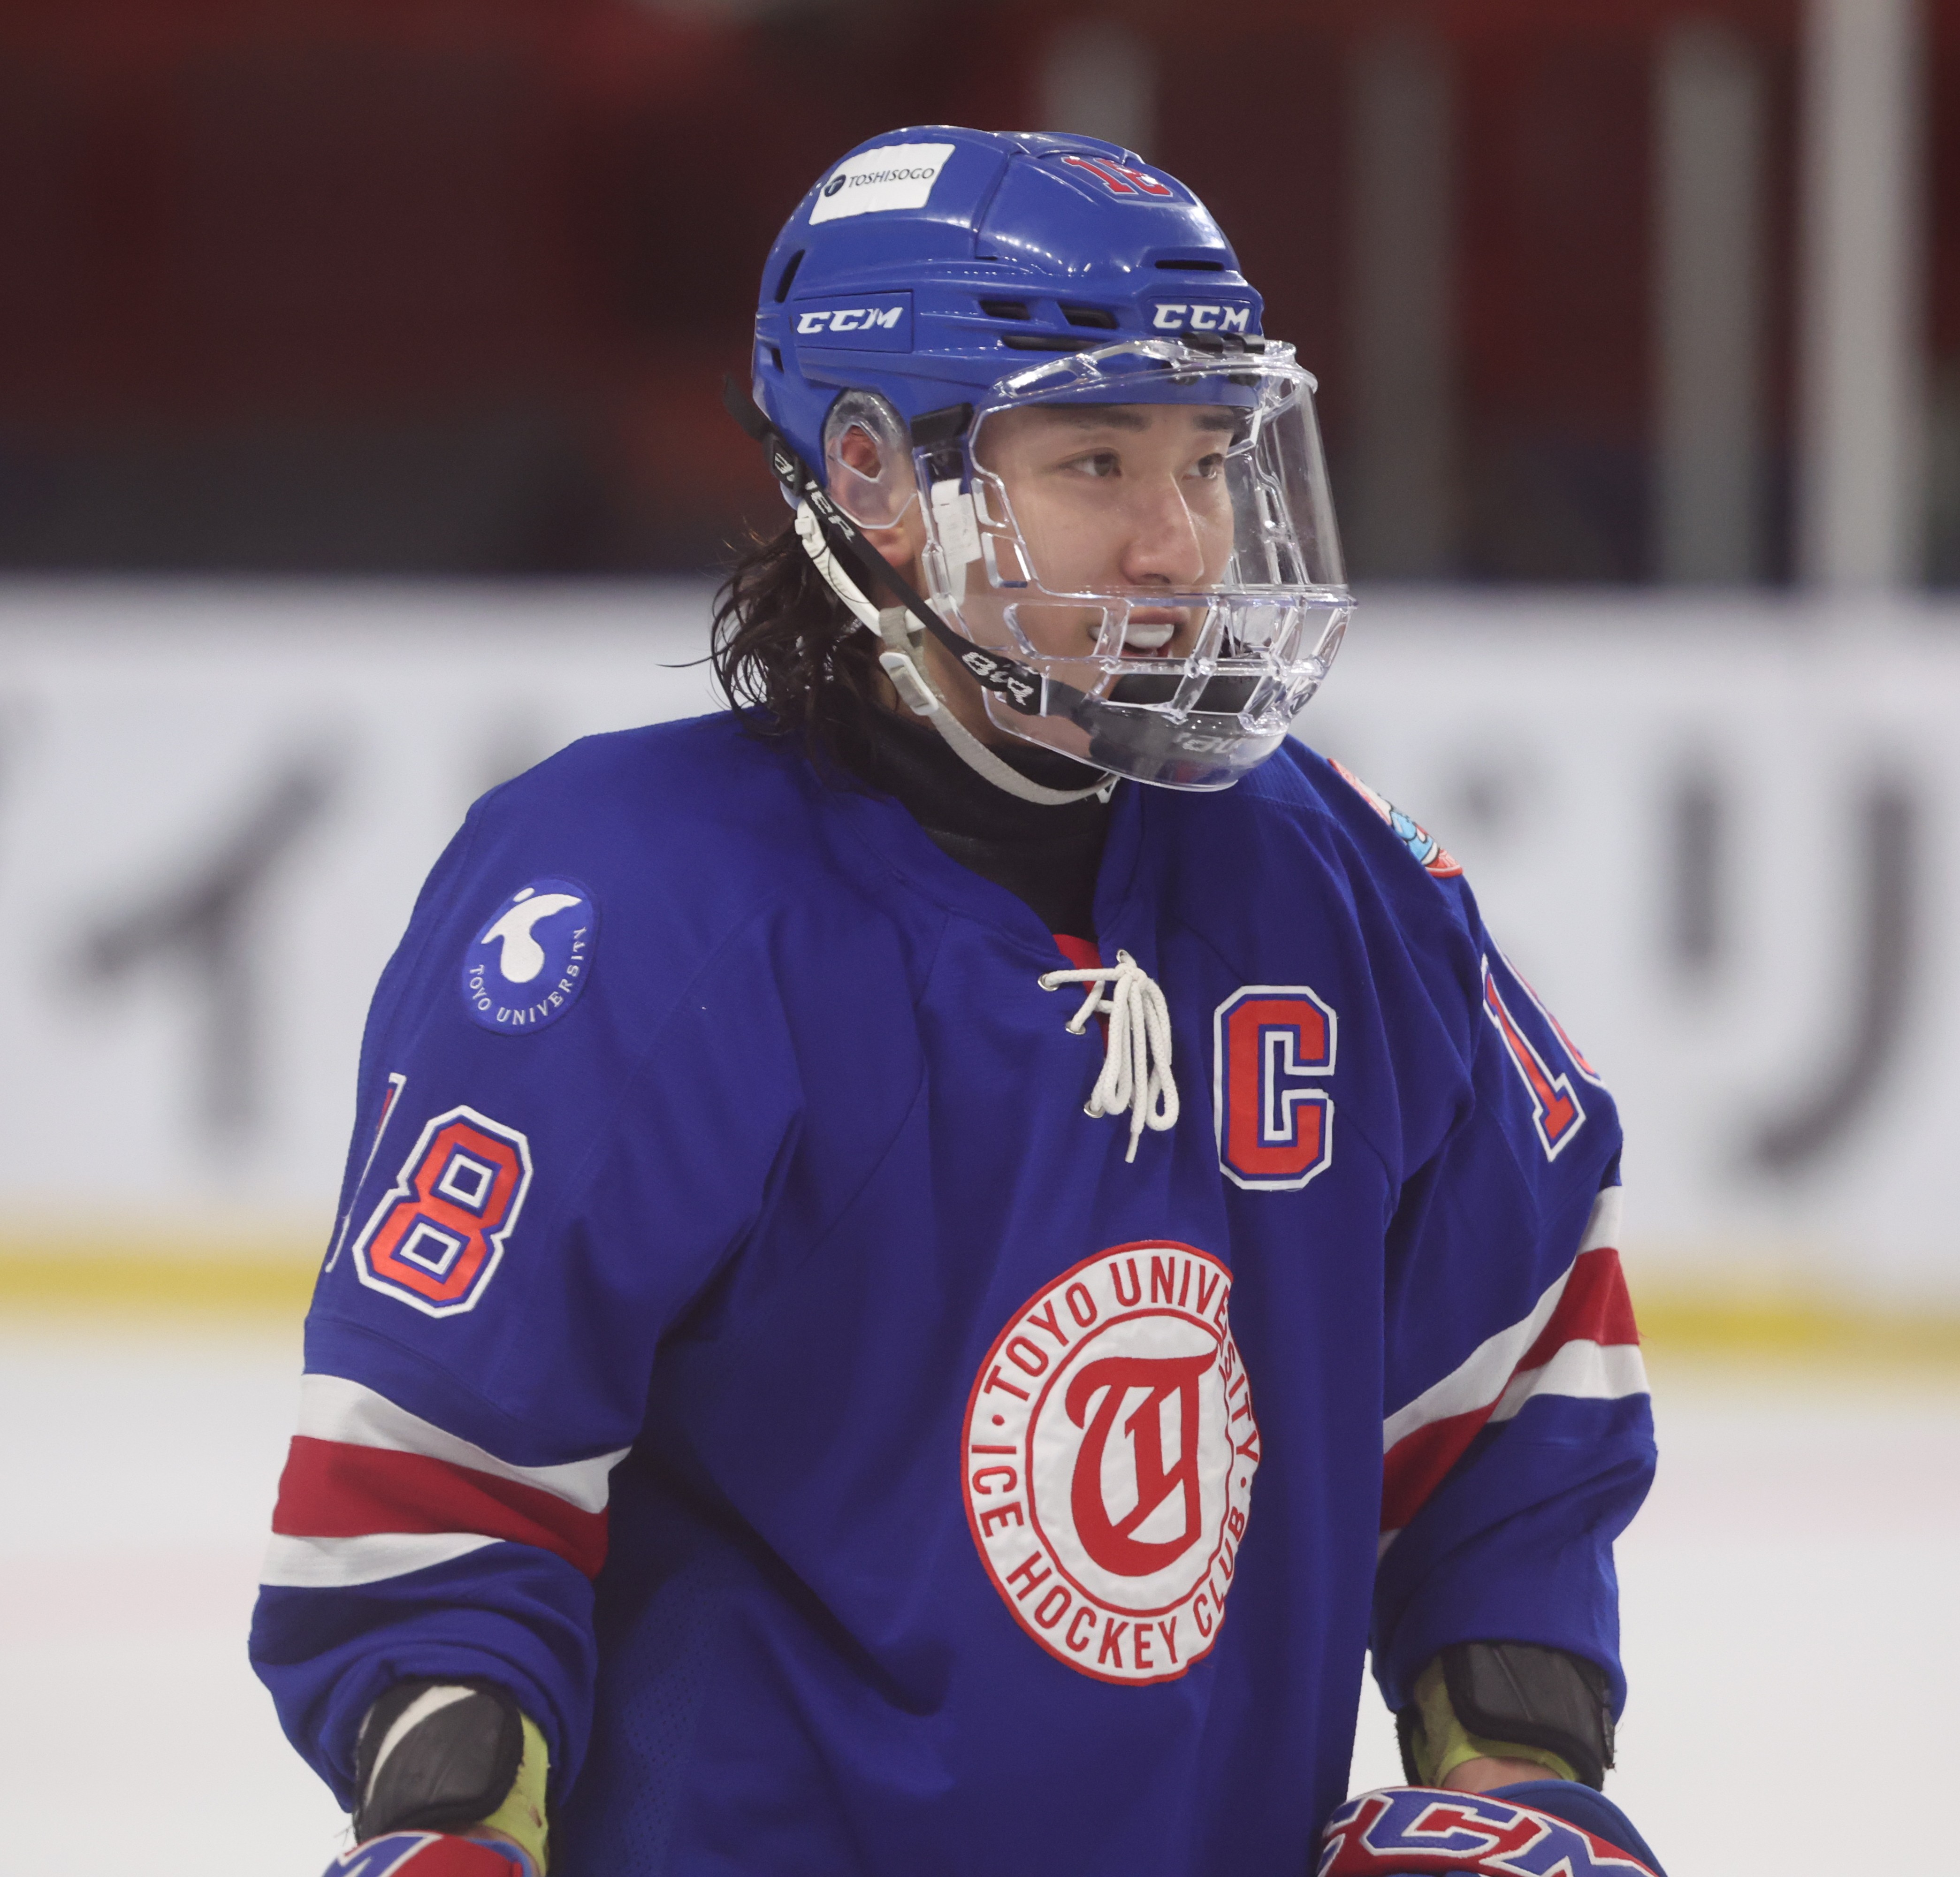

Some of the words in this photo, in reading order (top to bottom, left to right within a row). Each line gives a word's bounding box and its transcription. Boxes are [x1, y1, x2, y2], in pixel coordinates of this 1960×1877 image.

[849, 168, 934, 188] TOSHISOGO
[797, 307, 903, 334] CCM
[1152, 304, 1251, 332] CCM
[470, 964, 492, 1010] TOYO
[496, 926, 587, 1025] UNIVERSITY
[1213, 985, 1338, 1192] C
[984, 1282, 1098, 1402] TOYO
[971, 1444, 1024, 1537] ICE
[1006, 1550, 1178, 1670] HOCKEY
[1193, 1506, 1245, 1638] CLUB
